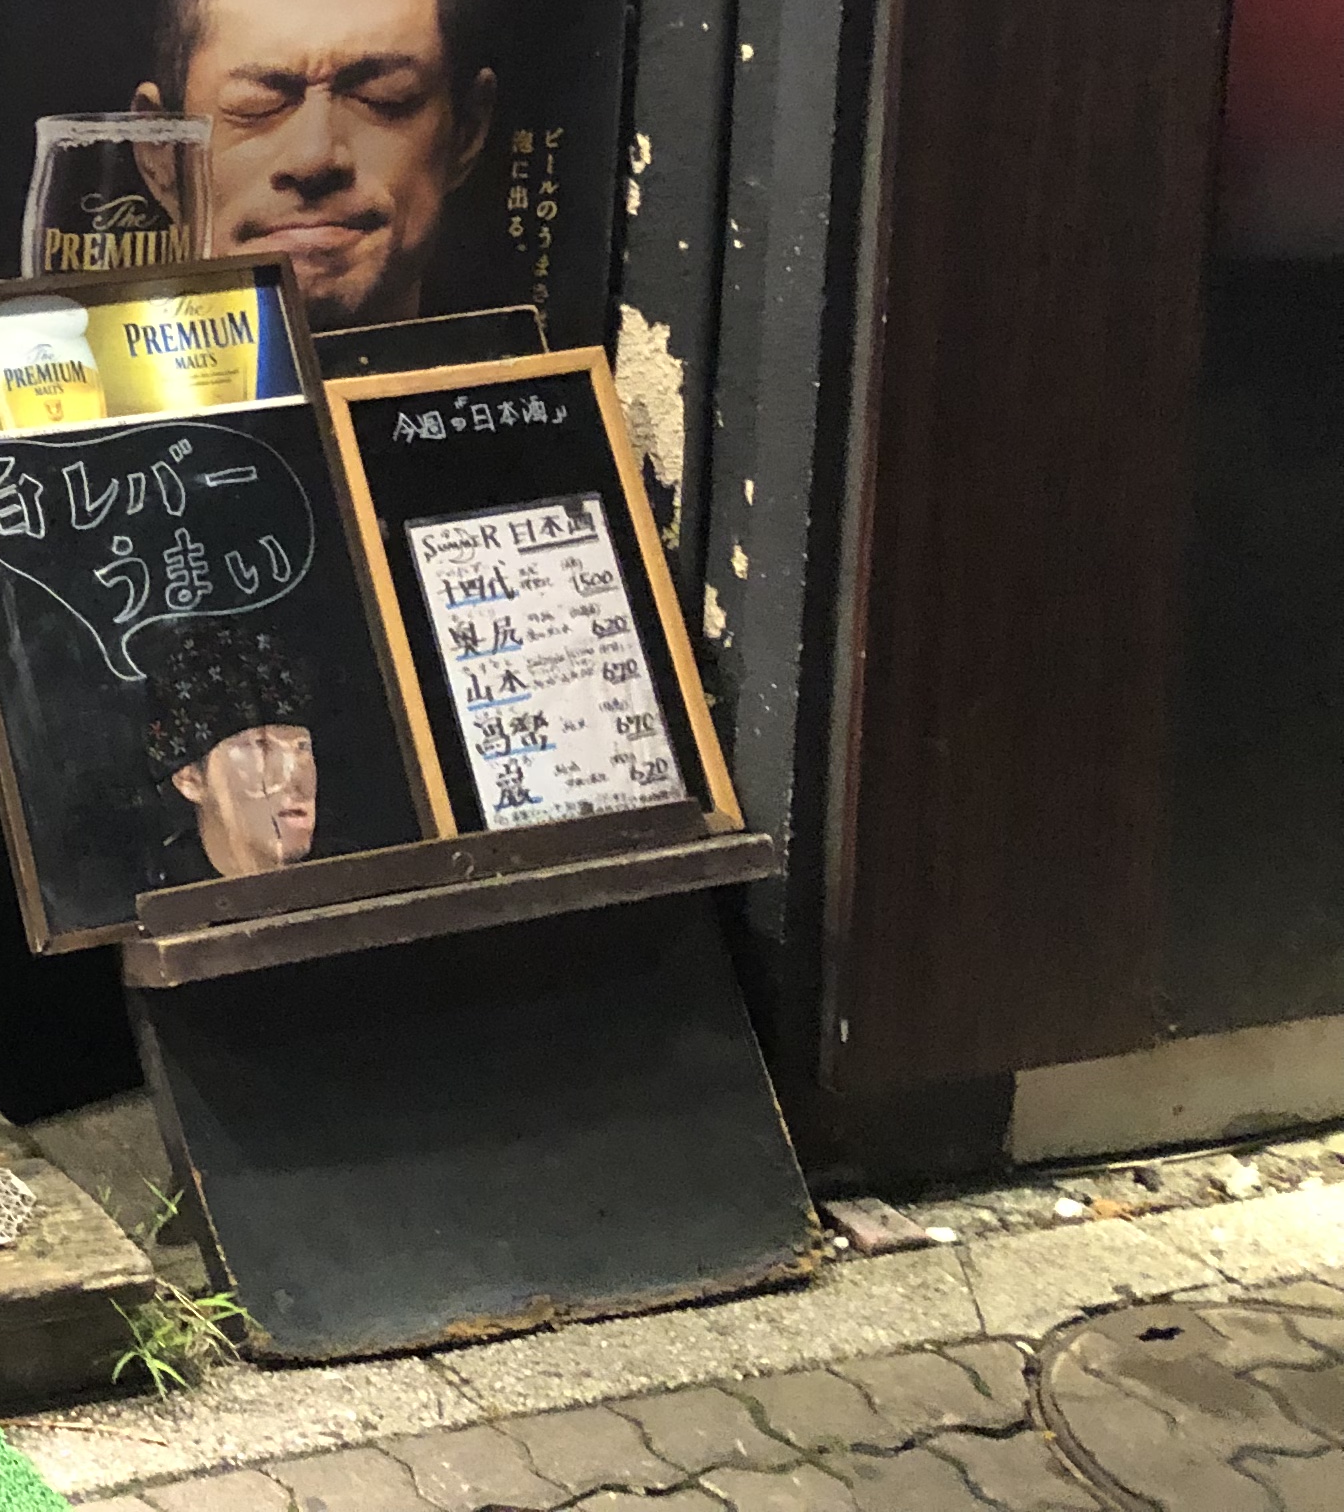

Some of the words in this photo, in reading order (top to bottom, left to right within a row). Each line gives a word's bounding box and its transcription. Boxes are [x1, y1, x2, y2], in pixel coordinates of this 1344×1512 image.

[81, 193, 159, 230] The
[44, 224, 190, 271] PREMIUM
[167, 296, 208, 318] The
[123, 311, 256, 358] PREMIUM
[3, 360, 87, 392] PREMIUM
[174, 353, 218, 370] MALT'S
[93, 528, 291, 623] うまい
[466, 669, 528, 702] 山本
